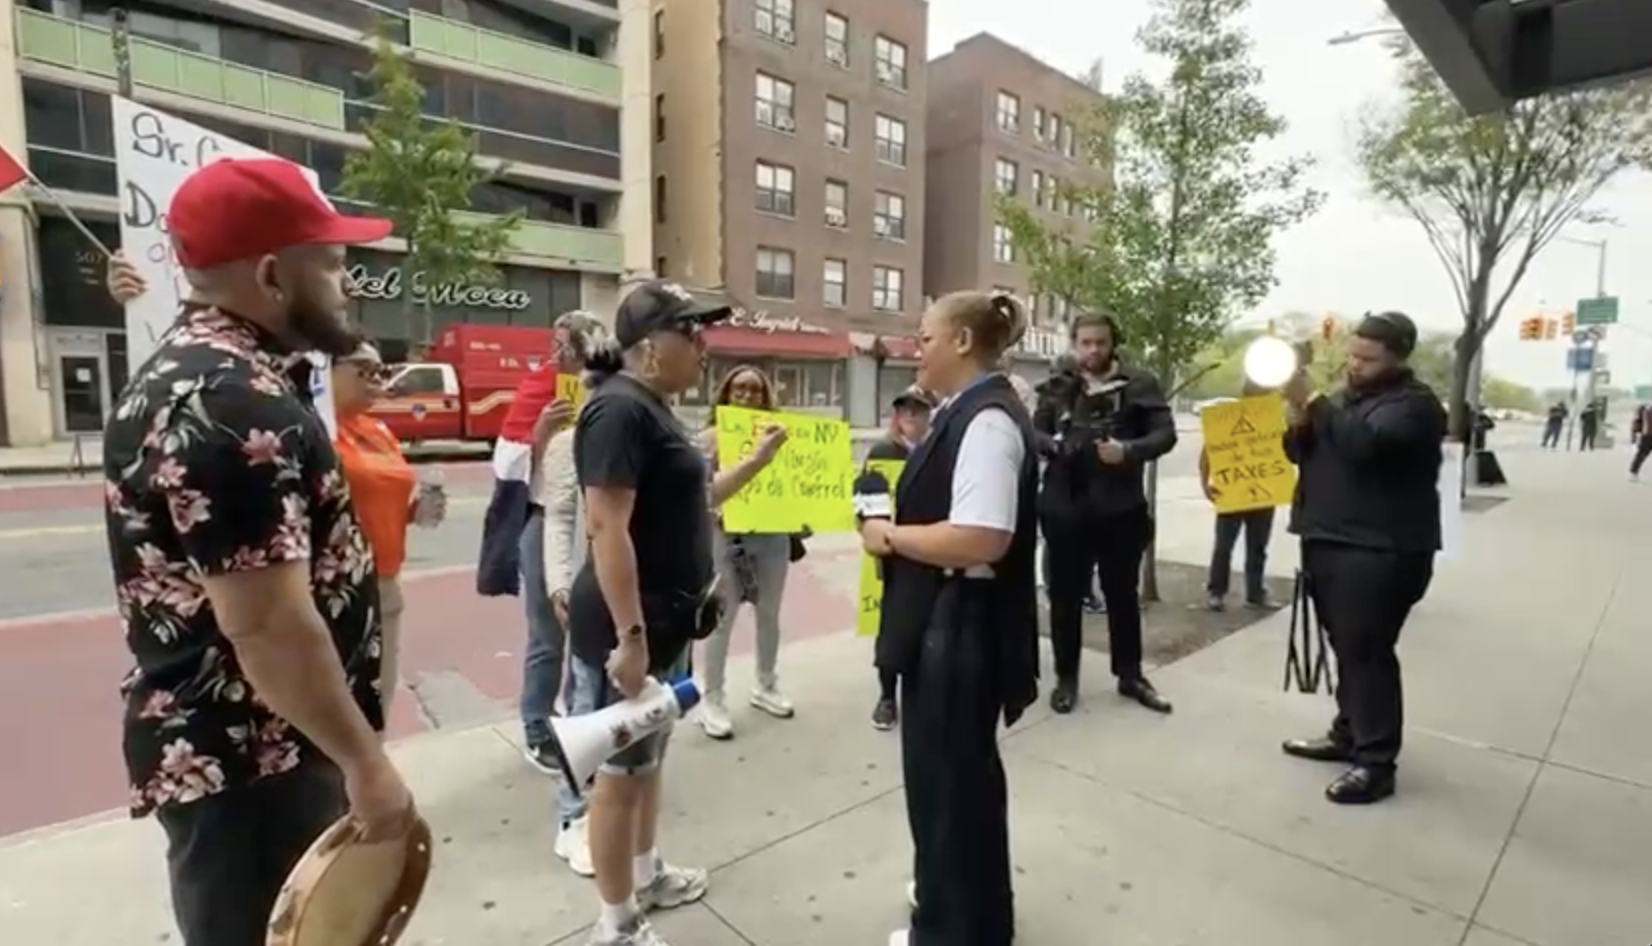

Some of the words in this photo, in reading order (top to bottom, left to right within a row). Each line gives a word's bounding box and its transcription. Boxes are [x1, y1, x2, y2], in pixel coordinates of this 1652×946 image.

[131, 112, 188, 167] Sr.
[346, 263, 402, 298] tel
[1215, 460, 1285, 485] TAXES
